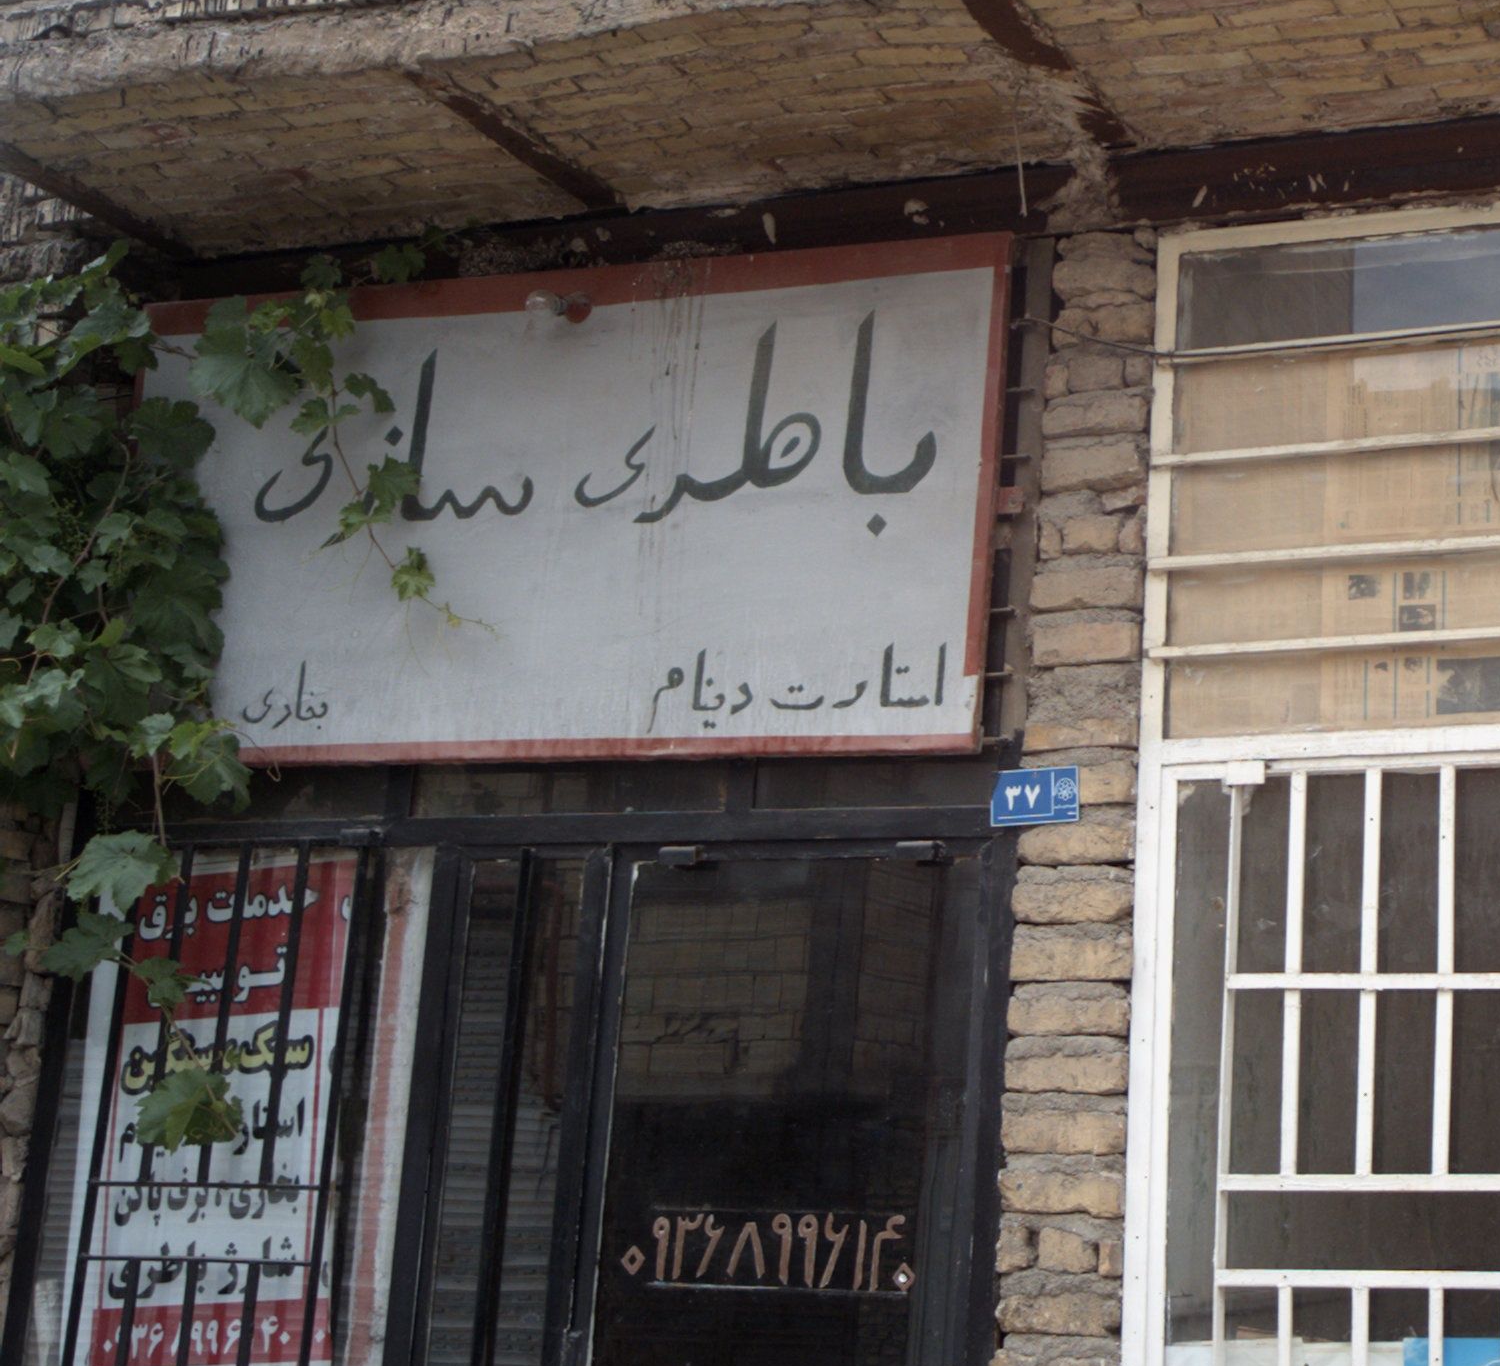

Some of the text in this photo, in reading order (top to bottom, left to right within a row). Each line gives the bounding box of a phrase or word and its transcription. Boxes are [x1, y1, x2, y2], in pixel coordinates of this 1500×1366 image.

[254, 308, 938, 547] باطری سازی
[241, 659, 329, 731] بخاری
[646, 641, 947, 735] استارت دینام
[1004, 783, 1041, 811] ۳۷
[216, 1235, 297, 1296] شاژ
[620, 1212, 917, 1293] ۰۹۳۶۸۹۹۶۱۴۰
[102, 1314, 292, 1361] ۰۳۶۹۹۶۴۰
